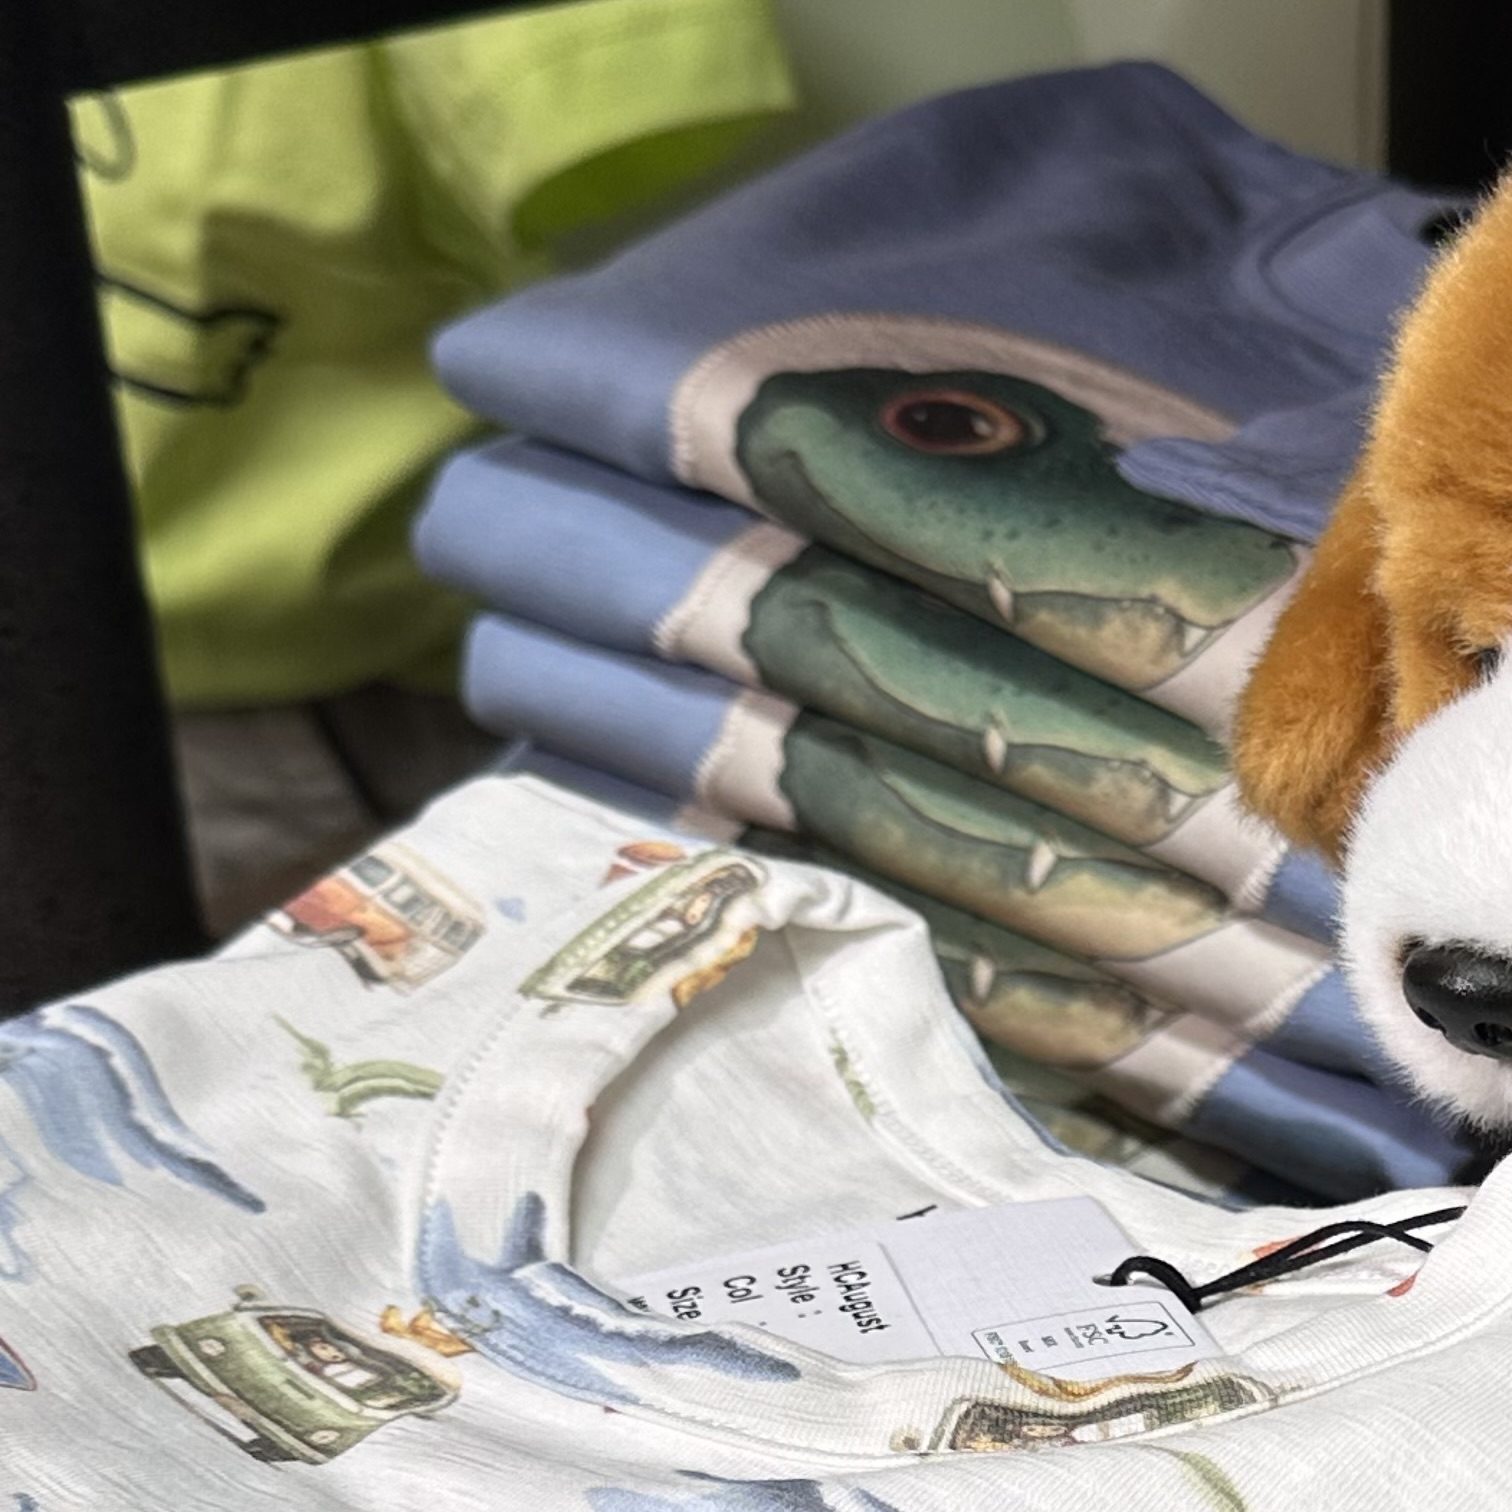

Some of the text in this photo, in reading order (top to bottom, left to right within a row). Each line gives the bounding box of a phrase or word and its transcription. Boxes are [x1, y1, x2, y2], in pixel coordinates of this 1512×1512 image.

[723, 1275, 764, 1304] Col
[774, 1263, 820, 1304] Style
[826, 1260, 892, 1334] HCAugust
[666, 1286, 704, 1320] Size
